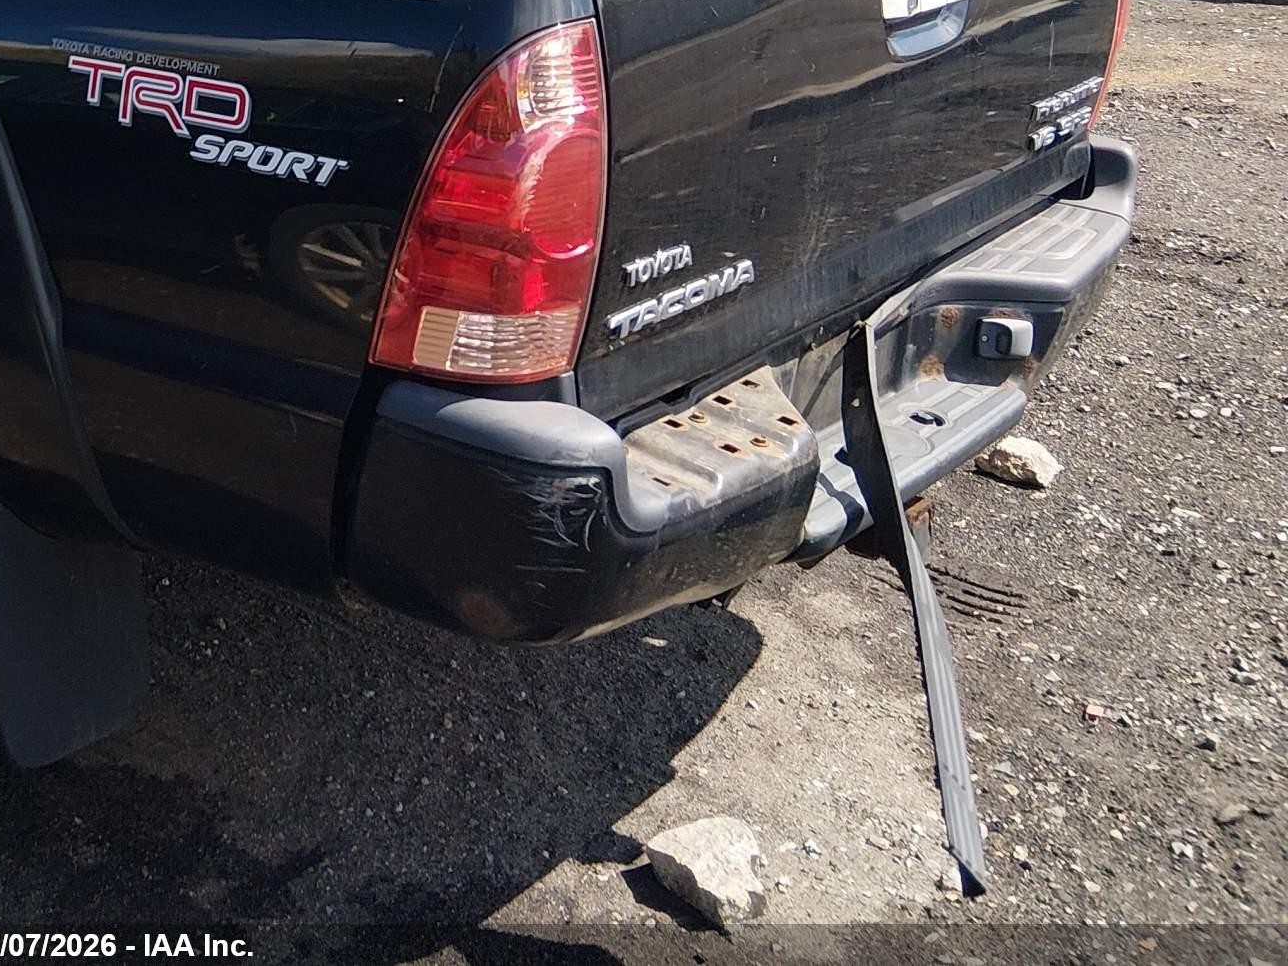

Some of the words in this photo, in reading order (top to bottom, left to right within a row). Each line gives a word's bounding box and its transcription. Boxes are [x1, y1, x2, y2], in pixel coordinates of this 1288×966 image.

[52, 38, 89, 55] TOYOTA
[93, 45, 133, 62] RACING
[137, 52, 221, 77] DEVELOPMENT
[67, 56, 253, 138] TRD
[189, 134, 350, 188] SPORT
[622, 244, 693, 287] TOYOTA
[604, 259, 755, 339] TACOMA
